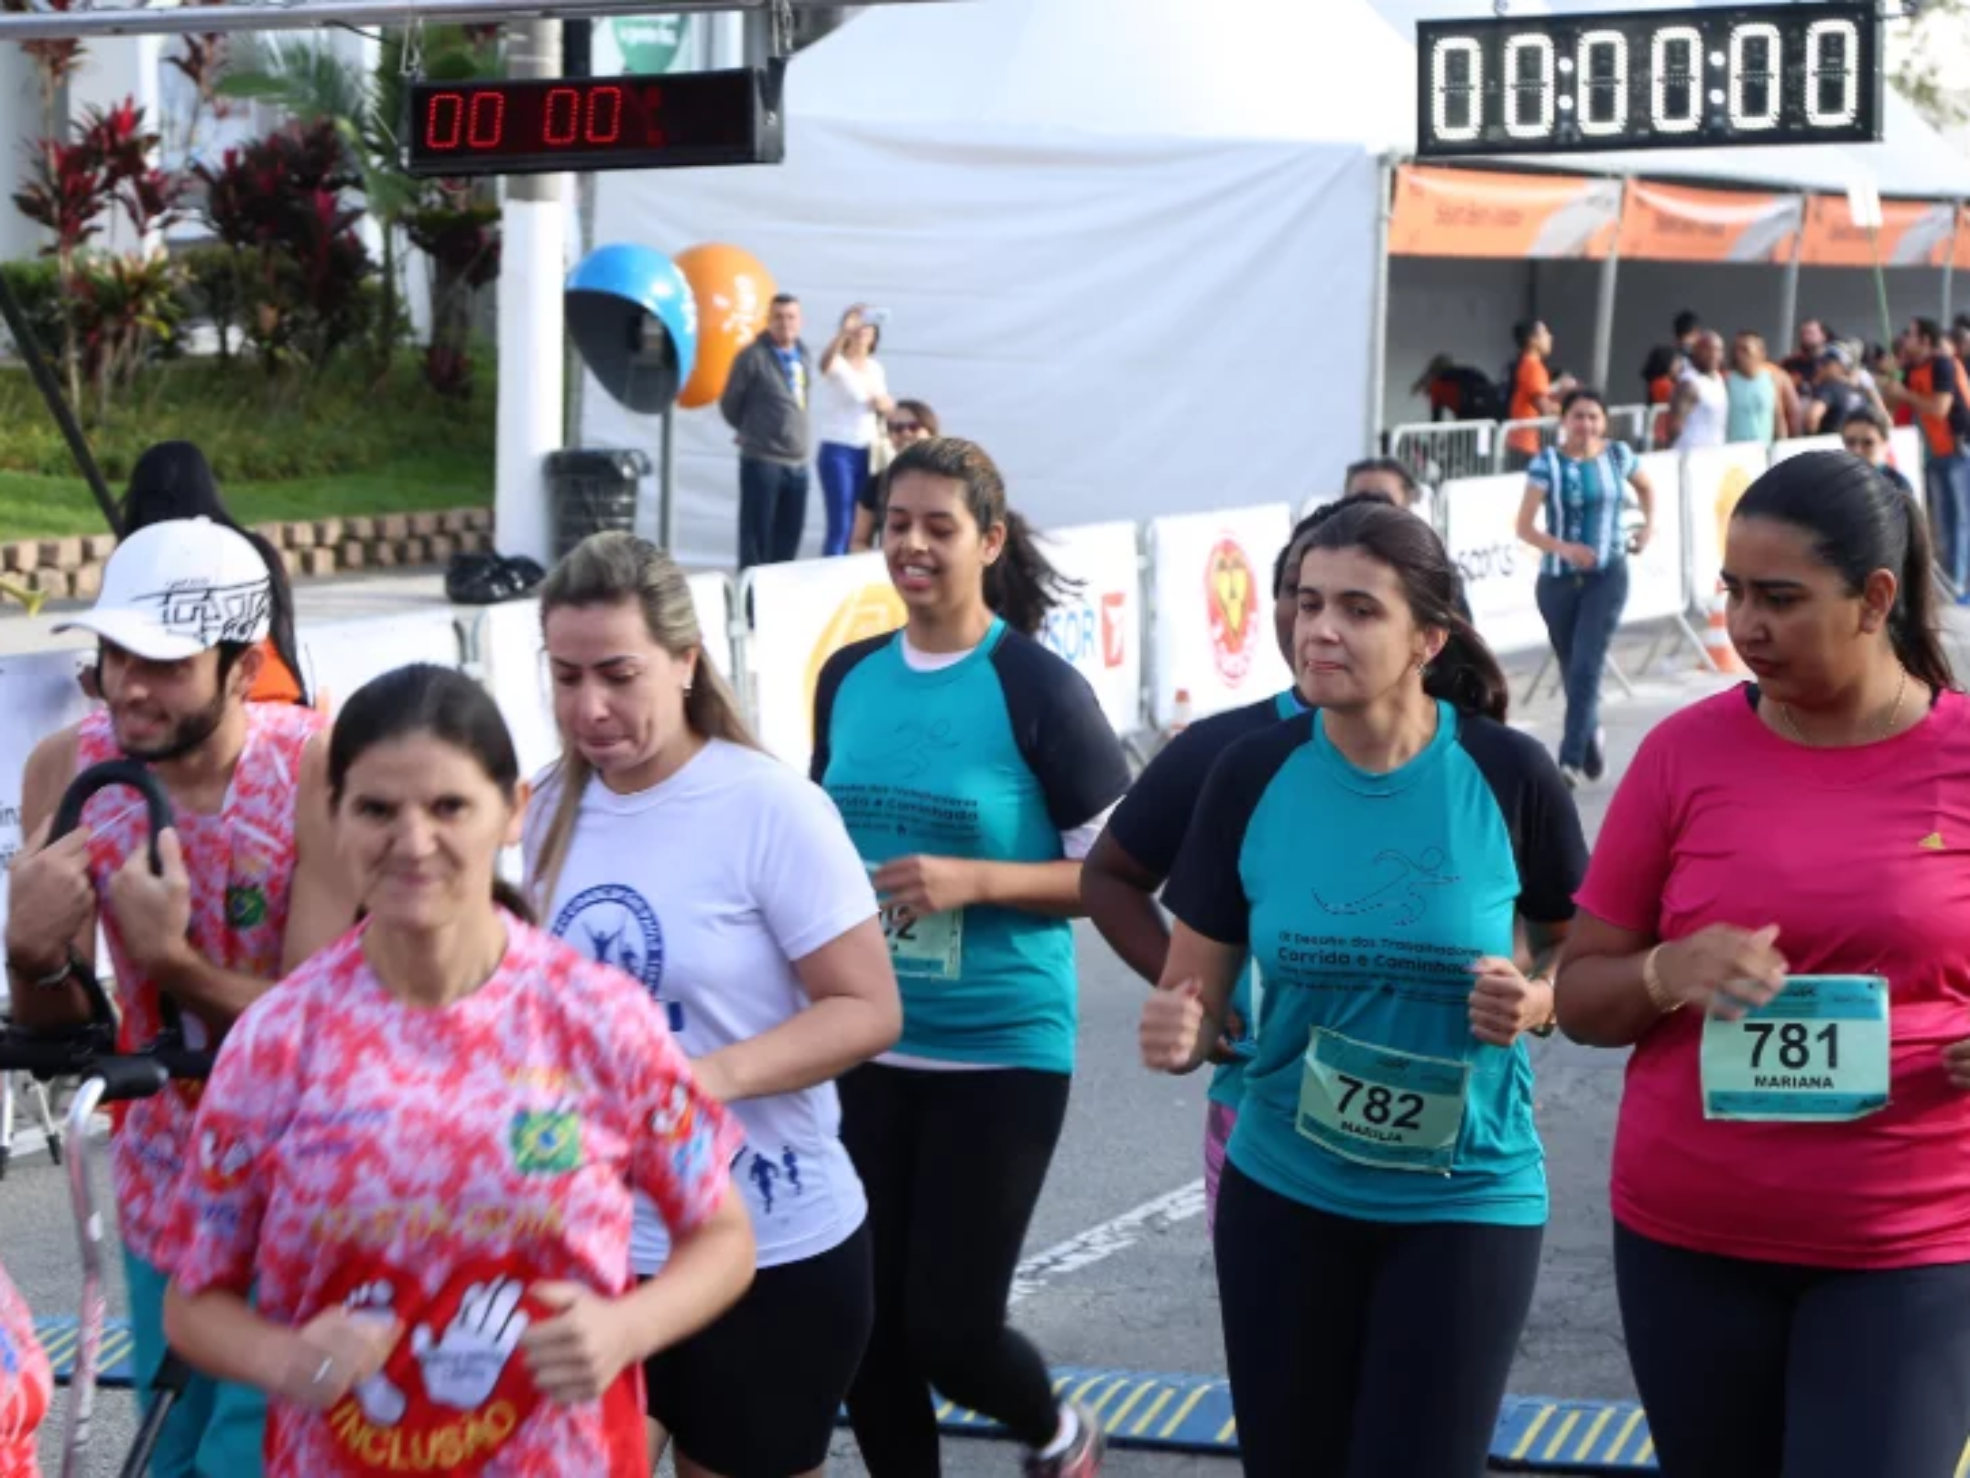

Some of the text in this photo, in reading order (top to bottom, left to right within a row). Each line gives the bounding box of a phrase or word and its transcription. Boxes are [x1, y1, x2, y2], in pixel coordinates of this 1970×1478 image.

[427, 86, 621, 148] 00 00
[1278, 946, 1352, 966] Corrida
[1356, 954, 1369, 967] e
[1744, 1022, 1838, 1070] 781
[1337, 1074, 1424, 1131] 782
[1754, 1075, 1834, 1089] MARIANA
